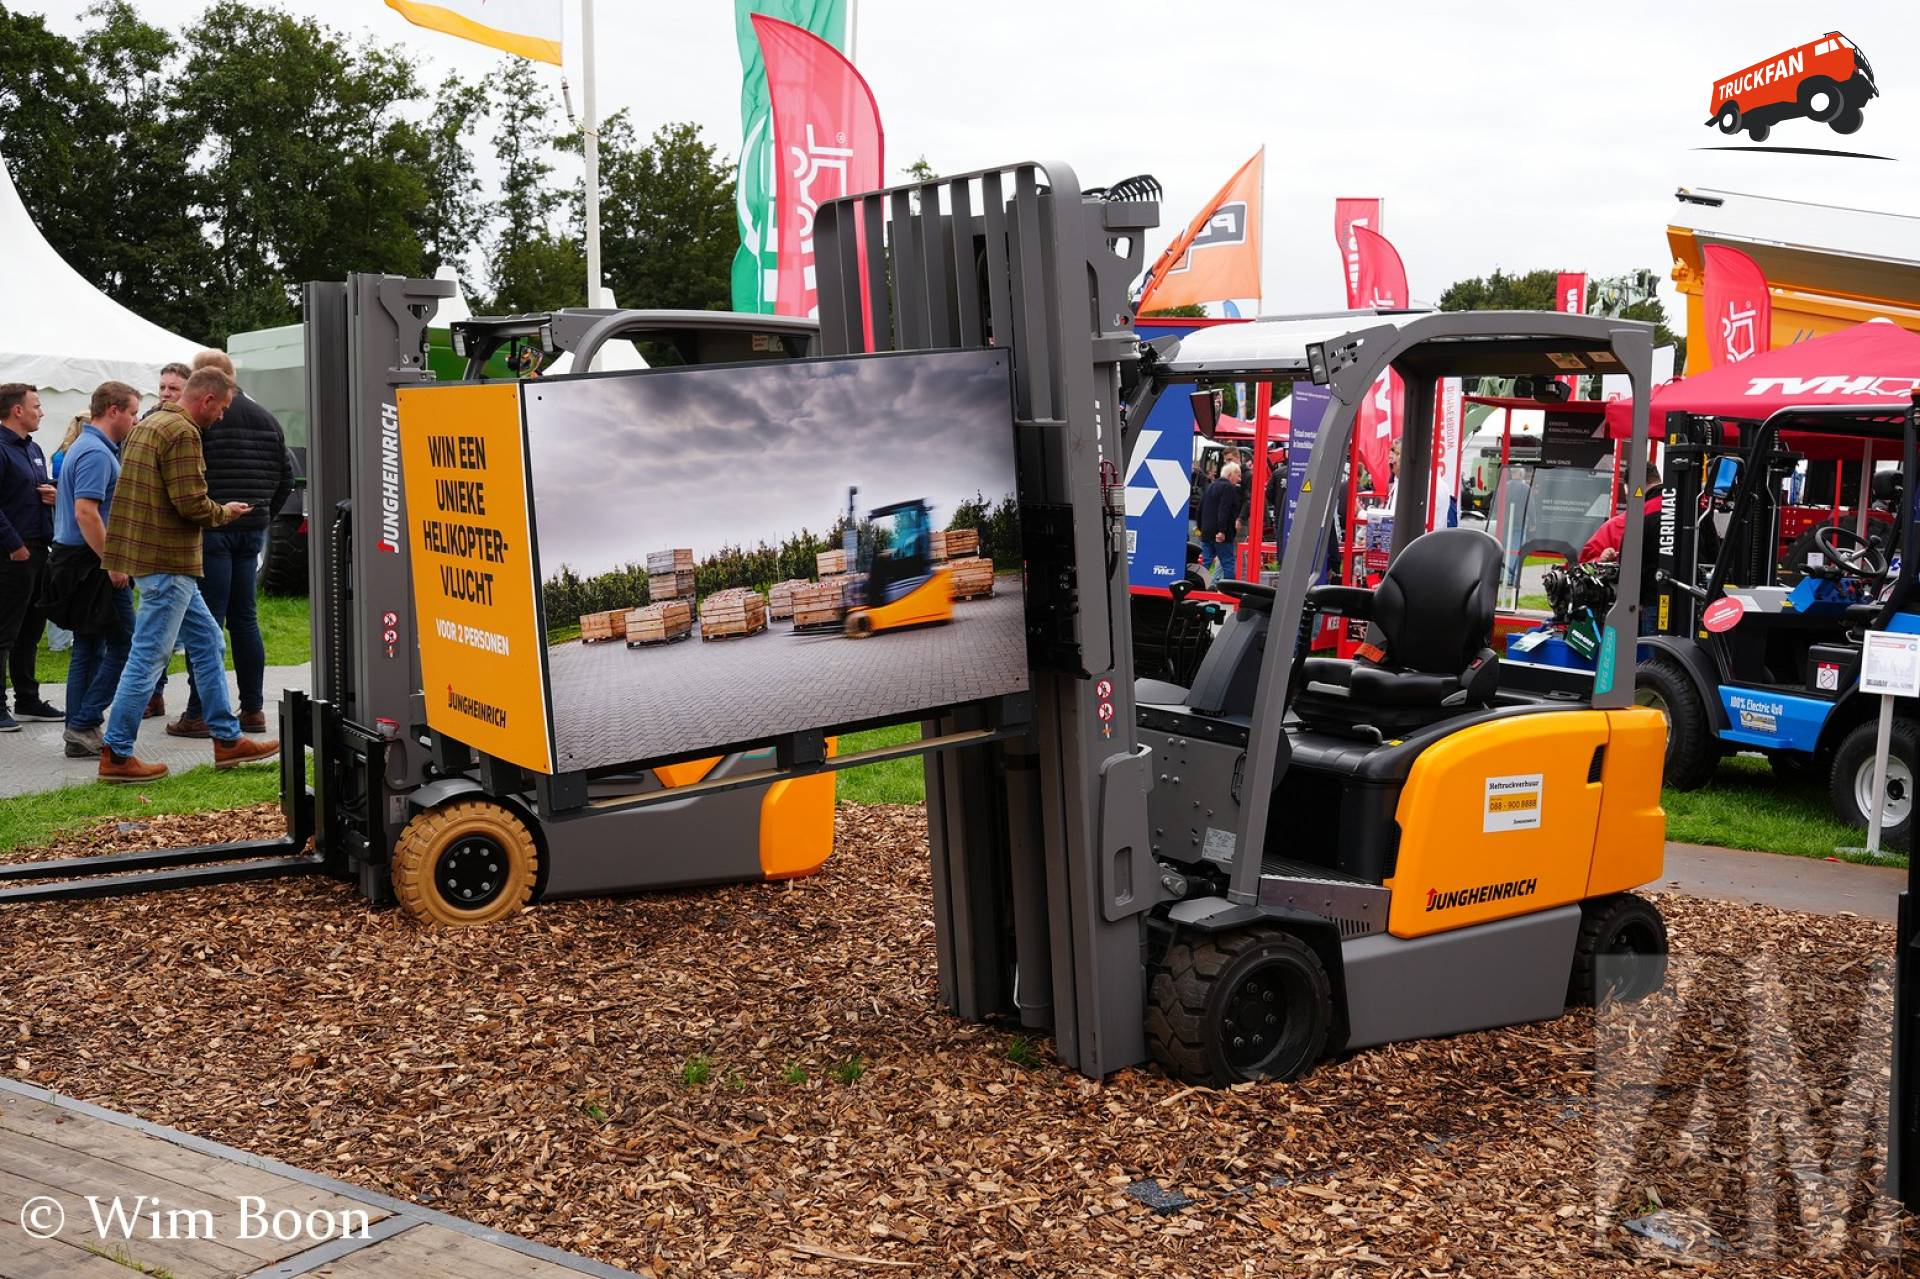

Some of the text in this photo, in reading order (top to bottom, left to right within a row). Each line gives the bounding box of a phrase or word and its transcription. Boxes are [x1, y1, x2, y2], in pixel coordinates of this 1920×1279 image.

[1744, 375, 1877, 396] TVH
[427, 435, 486, 471] WIN EEN
[379, 403, 399, 553] JUNGHEINRICH
[435, 479, 486, 516] UNIEKE
[1659, 487, 1677, 556] AGRIMAC
[422, 520, 509, 564] HELIKOPTER-
[440, 564, 494, 606] VLUCHT
[435, 617, 510, 657] VOOR 2 PERSONEN
[447, 685, 507, 729] JUNGHEINRICH
[1730, 695, 1746, 710] 100%
[1746, 699, 1770, 714] Electric
[1425, 878, 1538, 912] JUNGHEINRICH
